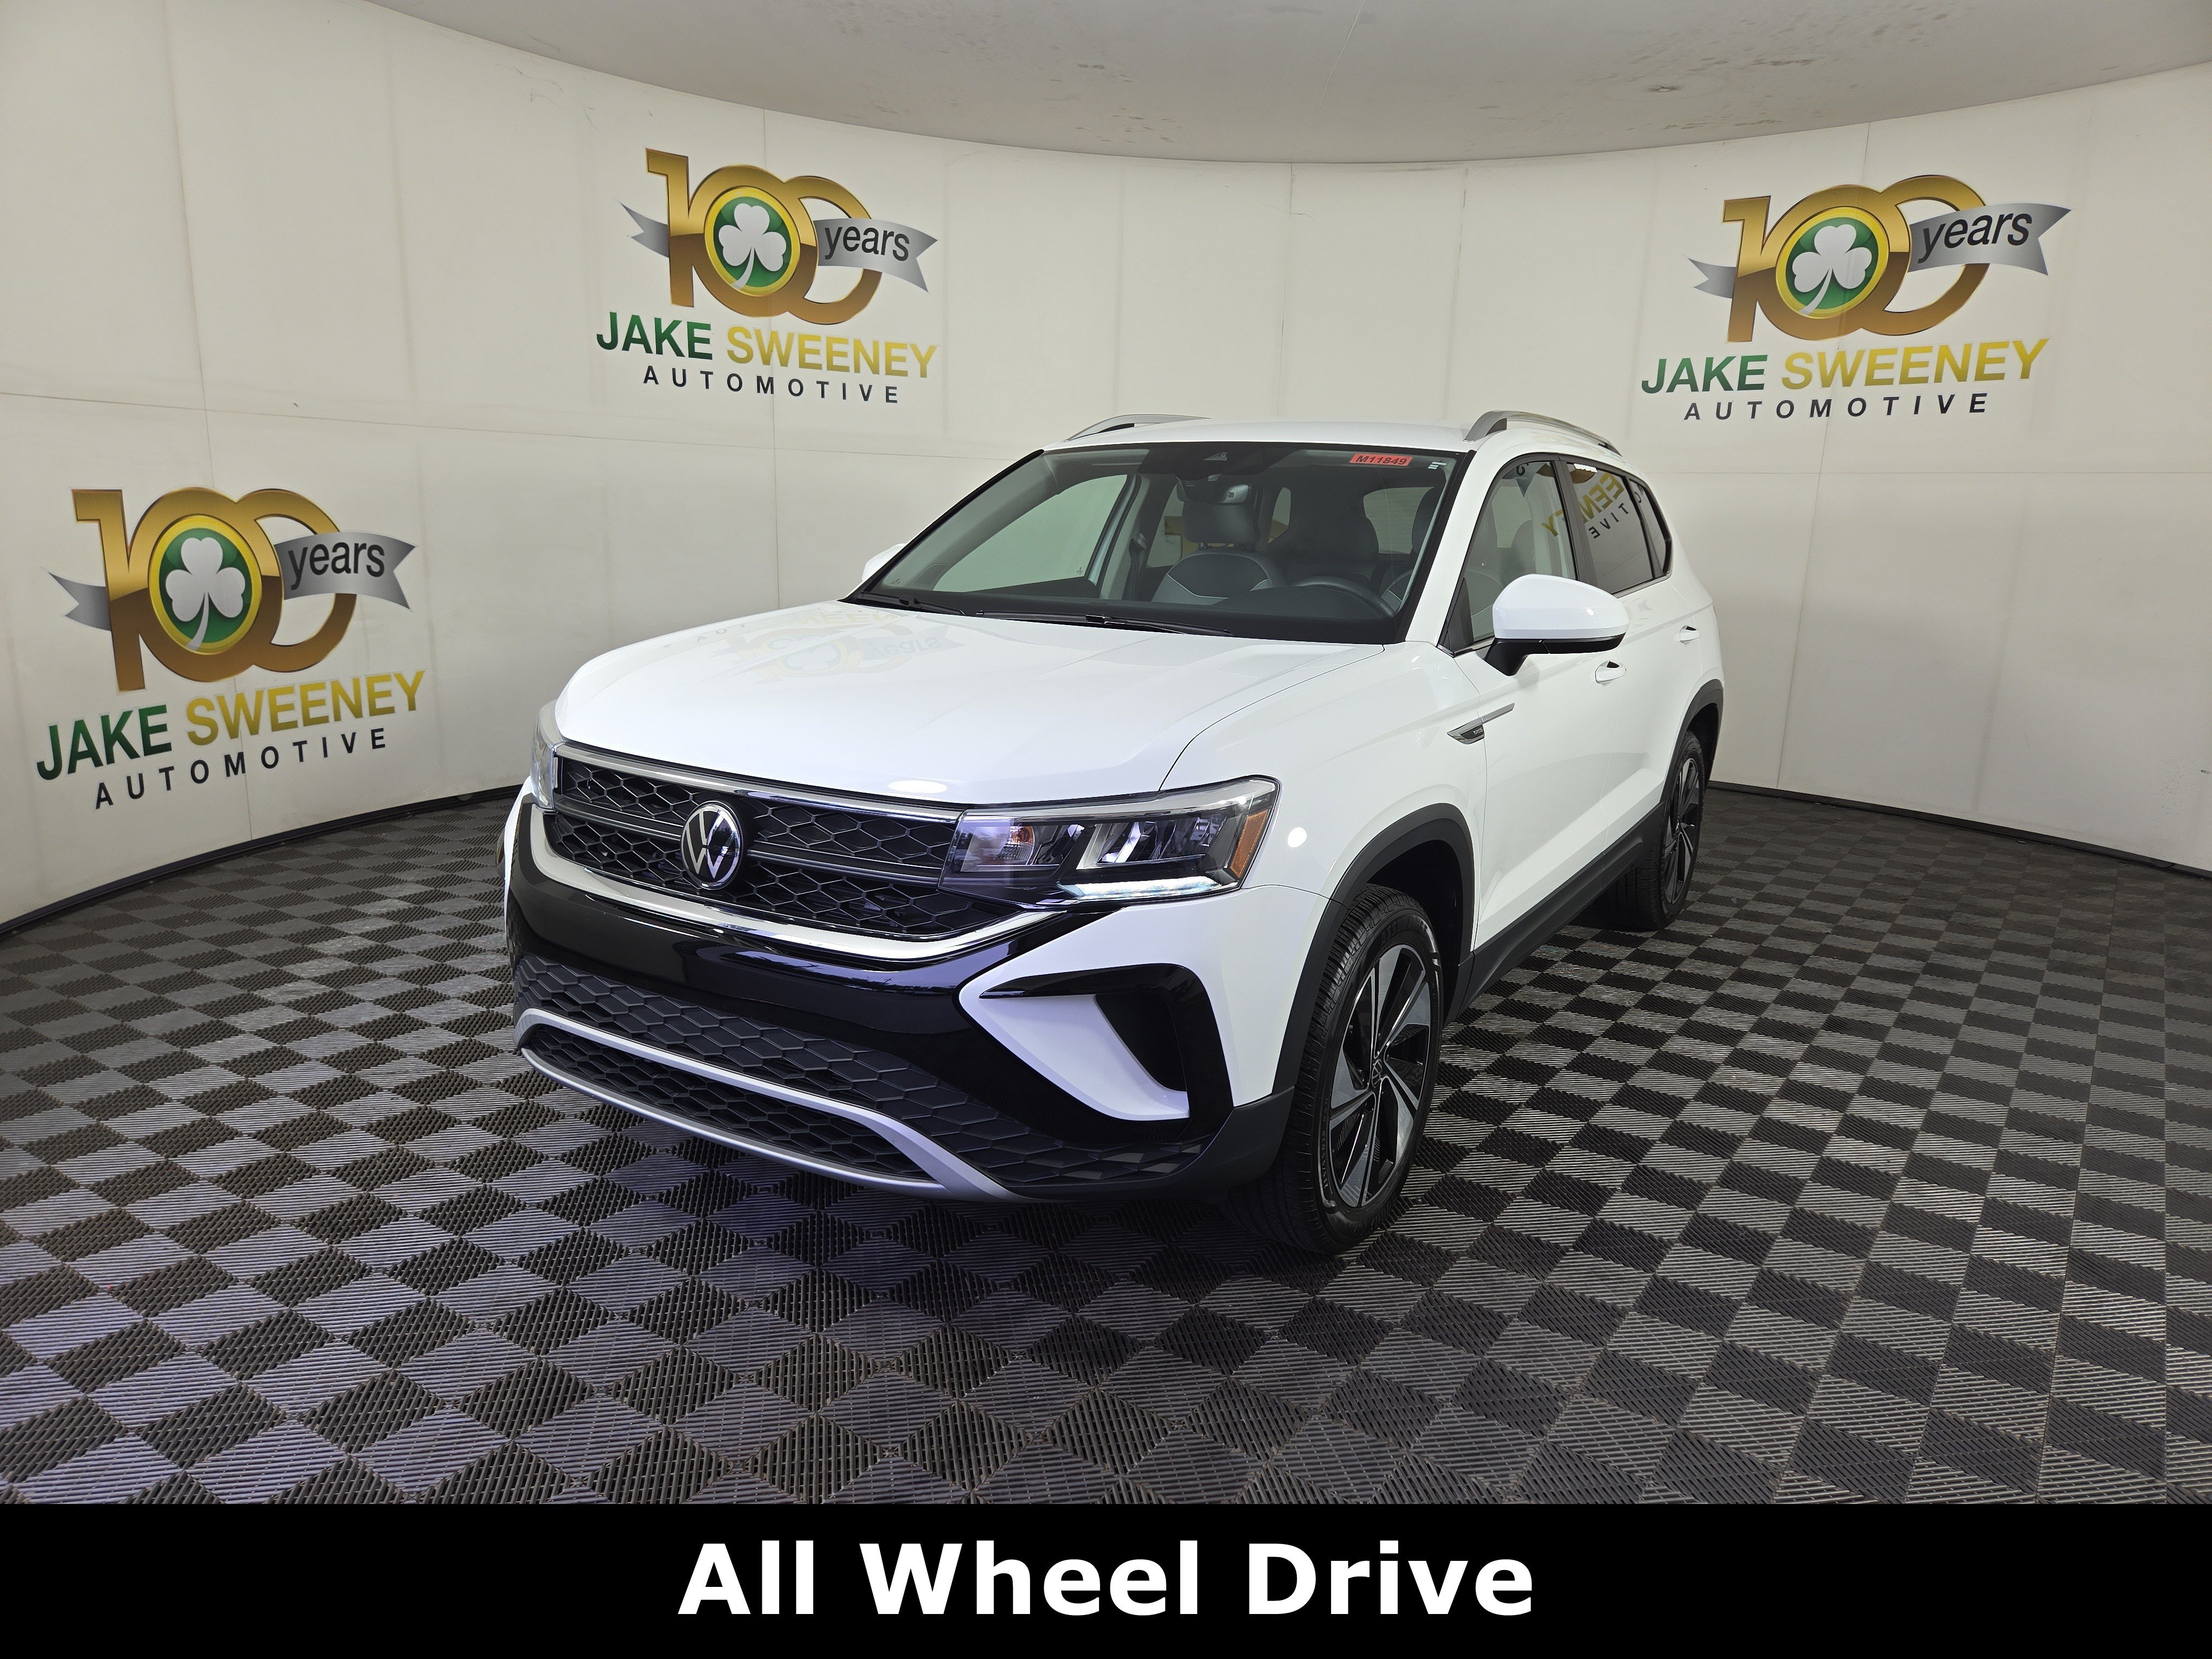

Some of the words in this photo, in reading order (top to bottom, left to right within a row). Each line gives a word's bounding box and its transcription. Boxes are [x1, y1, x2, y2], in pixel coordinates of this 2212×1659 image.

[824, 226, 909, 261] years
[1918, 213, 2032, 263] years
[597, 312, 713, 360] JAKE
[726, 326, 937, 378] SWEENEY
[1641, 355, 1767, 394] JAKE
[1782, 339, 2049, 390] SWEENEY
[644, 365, 898, 403] AUTOMOTIVE
[1684, 393, 1988, 420] AUTOMOTIVE
[1355, 455, 1407, 465] M11849
[288, 542, 385, 590] years
[36, 705, 172, 780] JAKE
[186, 670, 426, 746] SWEENEY
[1472, 727, 1483, 735] TAOS
[95, 728, 385, 809] AUTOMOTIVE
